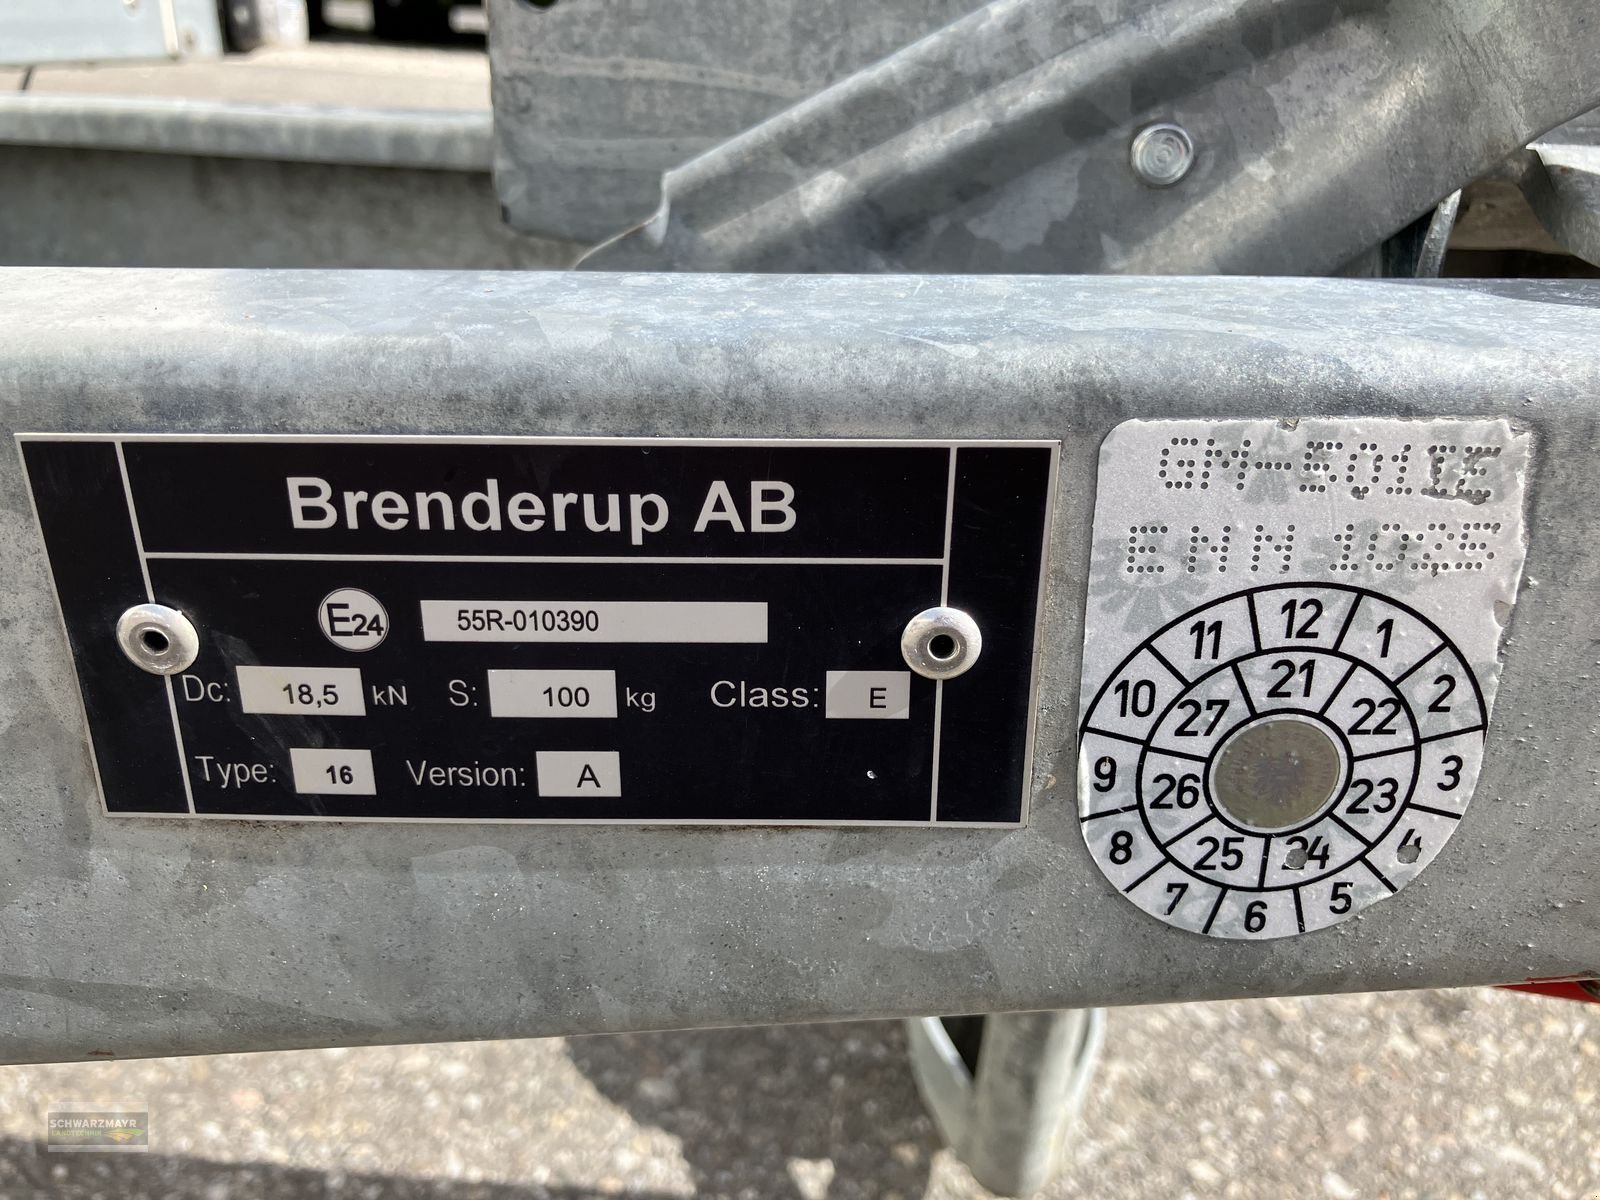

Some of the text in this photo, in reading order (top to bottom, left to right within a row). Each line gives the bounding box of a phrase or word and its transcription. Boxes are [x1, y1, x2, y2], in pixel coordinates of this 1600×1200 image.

[285, 476, 798, 546] Brenderup AB
[326, 603, 384, 637] E24
[457, 609, 600, 633] 55R-010390
[1280, 598, 1323, 640] 12
[1189, 621, 1222, 659] 11
[1376, 619, 1393, 658] 1
[182, 675, 408, 709] Dc: 18,5 kN
[449, 680, 656, 712] S: 100 kg
[710, 681, 887, 708] Class: E
[1267, 660, 1316, 698] 21
[1428, 675, 1456, 712] 2
[1114, 679, 1156, 717] 10
[1174, 699, 1229, 736] 27
[1348, 698, 1402, 735] 22
[195, 755, 353, 789] Type: 16
[407, 760, 601, 788] Version: A
[1093, 756, 1116, 790] 9
[1436, 755, 1463, 790] 3
[1150, 774, 1200, 809] 26
[1346, 779, 1398, 814] 23
[1109, 831, 1133, 864] 8
[1194, 837, 1244, 870] 25
[1165, 883, 1189, 915] 7
[1329, 882, 1354, 913] 5
[1244, 901, 1267, 932] 6
